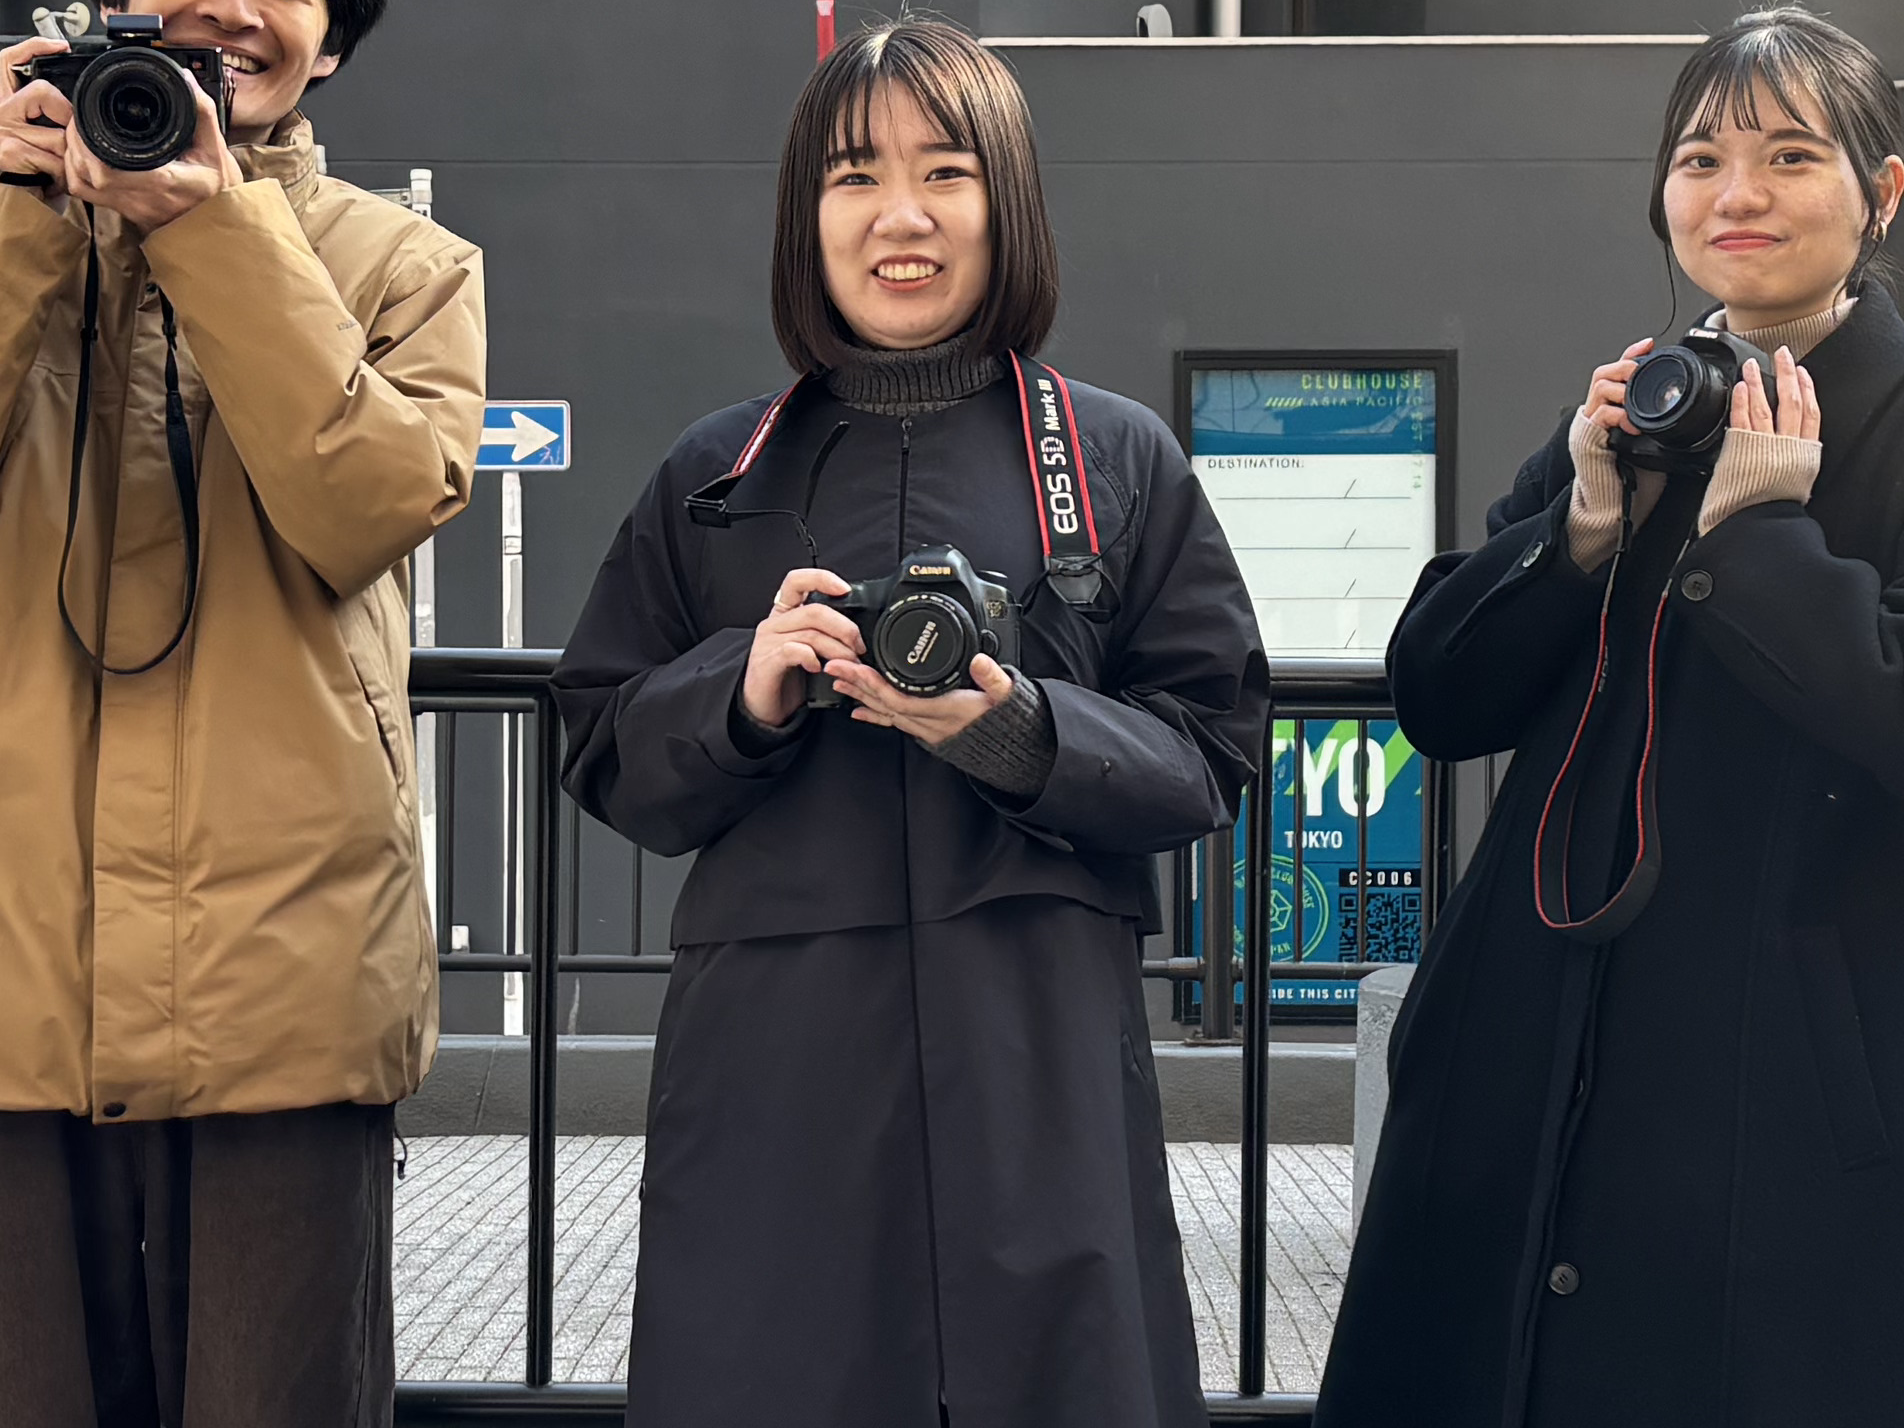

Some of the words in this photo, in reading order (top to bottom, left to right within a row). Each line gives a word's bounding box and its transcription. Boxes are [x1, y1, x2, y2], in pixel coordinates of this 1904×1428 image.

[1301, 373, 1424, 390] CLUBHOUSE
[1040, 392, 1062, 431] Mark
[1040, 436, 1067, 466] 5D
[1046, 473, 1079, 535] EOS
[909, 564, 952, 576] Canon
[906, 620, 937, 664] Canon
[1270, 988, 1294, 1000] IDE
[1299, 988, 1330, 1000] THIS
[1334, 988, 1358, 1000] CIT
